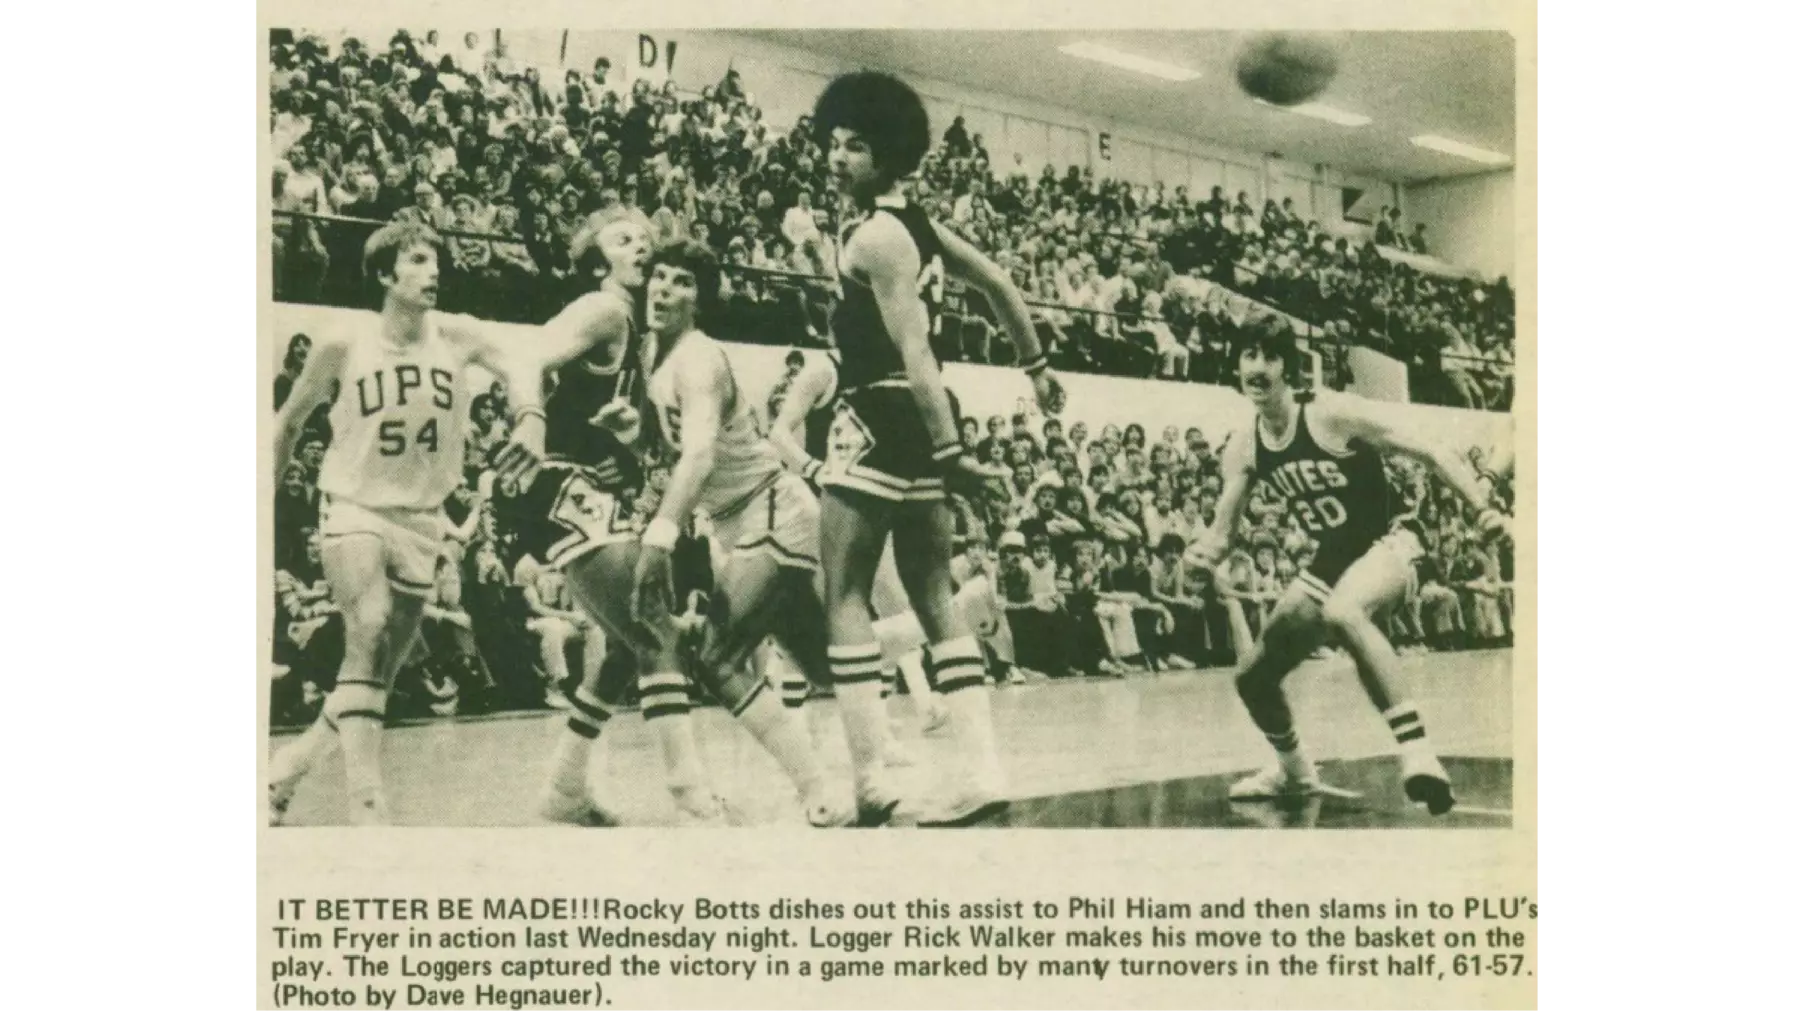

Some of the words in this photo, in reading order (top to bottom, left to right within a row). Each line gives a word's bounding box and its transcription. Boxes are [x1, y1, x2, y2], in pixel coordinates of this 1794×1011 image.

[357, 365, 452, 417] UPS
[379, 418, 438, 456] 54
[1295, 496, 1348, 531] 20
[279, 899, 305, 920] IT
[317, 899, 428, 920] BETTER
[439, 899, 472, 919] BE
[696, 898, 759, 919] Botts
[770, 898, 844, 919] dishes
[854, 902, 895, 919] out
[906, 899, 949, 919] this
[960, 899, 1022, 919] assist
[1034, 901, 1058, 918] to
[1070, 898, 1114, 918] Phil
[1127, 898, 1191, 918] Hiam
[1201, 898, 1244, 918] and
[1255, 898, 1309, 918] then
[1320, 899, 1386, 919] slams
[1396, 899, 1417, 918] in
[1428, 902, 1453, 919] to
[1465, 897, 1538, 919] PLU's
[273, 927, 321, 948] Tim
[334, 928, 399, 952] Fryer
[410, 927, 431, 947] in
[440, 927, 515, 948] action
[526, 927, 567, 948] last
[578, 926, 716, 951] Wednesday
[727, 927, 797, 952] night.
[811, 926, 892, 952] Logger
[905, 926, 959, 947] Rick
[970, 926, 1055, 947] Walker
[1067, 926, 1142, 947] makes
[1153, 926, 1185, 947] his
[1196, 931, 1261, 947] move
[1272, 929, 1296, 947] to
[1307, 926, 1345, 947] the
[1356, 926, 1434, 947] basket
[1444, 933, 1475, 947] on
[1486, 927, 1524, 947] the
[272, 956, 331, 981] play.
[343, 955, 388, 977] The
[402, 955, 491, 981] Loggers
[502, 955, 611, 980] captured
[621, 955, 659, 975] the
[670, 955, 756, 980] victory
[768, 955, 788, 975] in
[799, 961, 810, 976] a
[821, 961, 884, 981] game
[895, 955, 986, 976] marked
[998, 955, 1027, 979] by
[1120, 959, 1237, 975] turnovers
[1248, 955, 1268, 975] in
[1279, 955, 1317, 975] the
[1327, 955, 1378, 976] first
[1388, 955, 1443, 980] half,
[1453, 954, 1532, 975] 61-57.
[274, 983, 356, 1007] (Photo
[367, 985, 396, 1009] by
[408, 984, 464, 1005] Dave
[476, 983, 611, 1010] Hegnauer).
